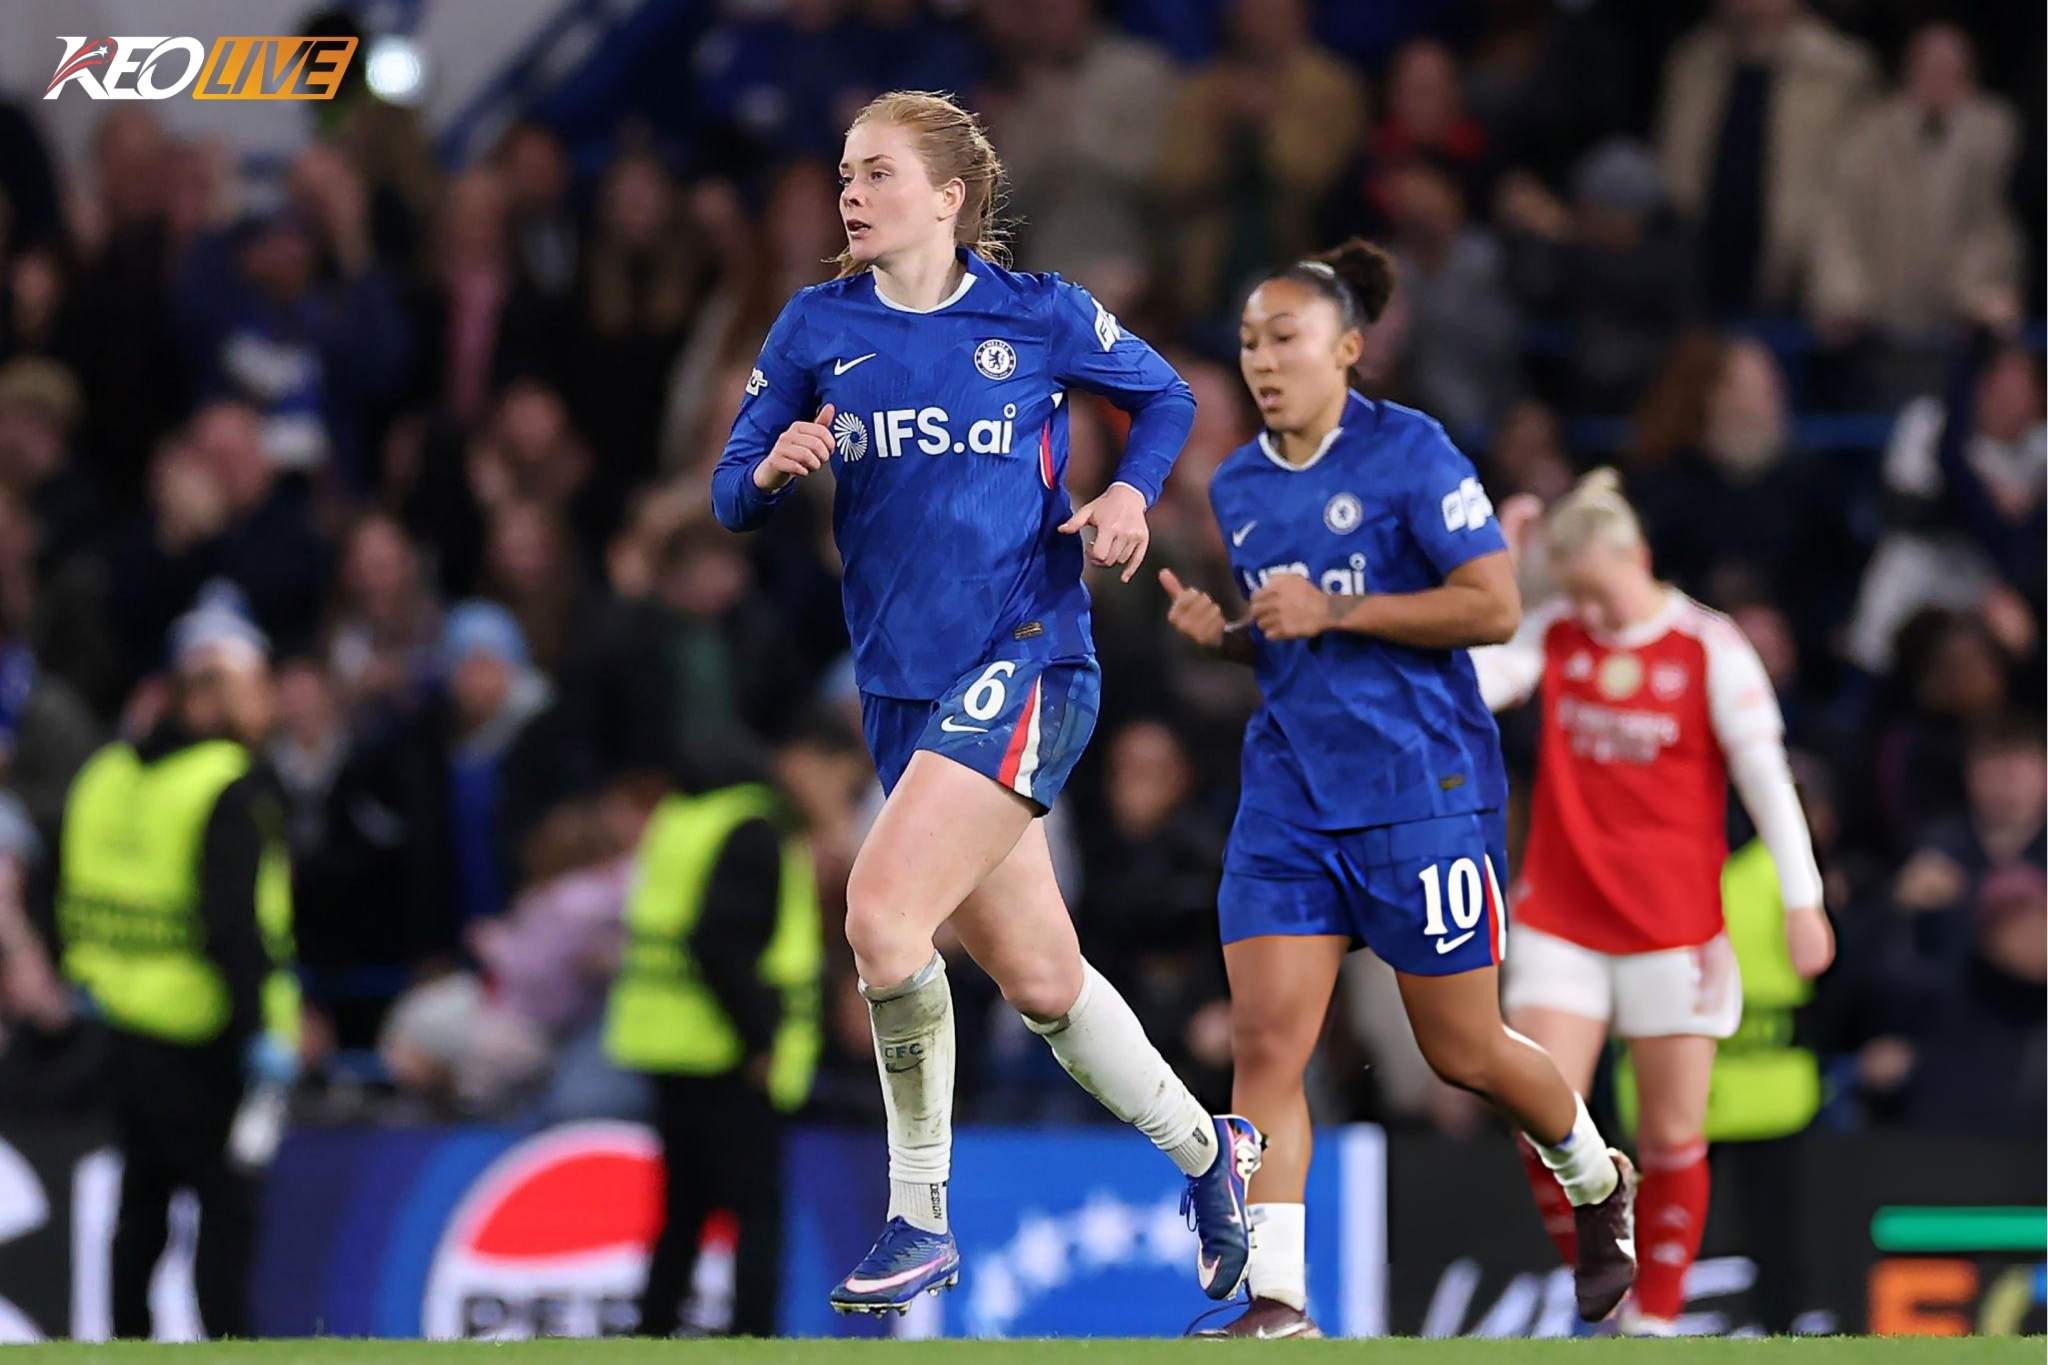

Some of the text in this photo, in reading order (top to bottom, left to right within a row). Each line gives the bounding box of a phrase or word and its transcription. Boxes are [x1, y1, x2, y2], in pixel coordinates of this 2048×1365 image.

[873, 403, 1017, 458] IFS.ai
[963, 660, 1016, 721] 6
[1418, 857, 1483, 936] 10
[884, 1042, 924, 1060] CFC
[929, 1182, 943, 1220] DESIGN
